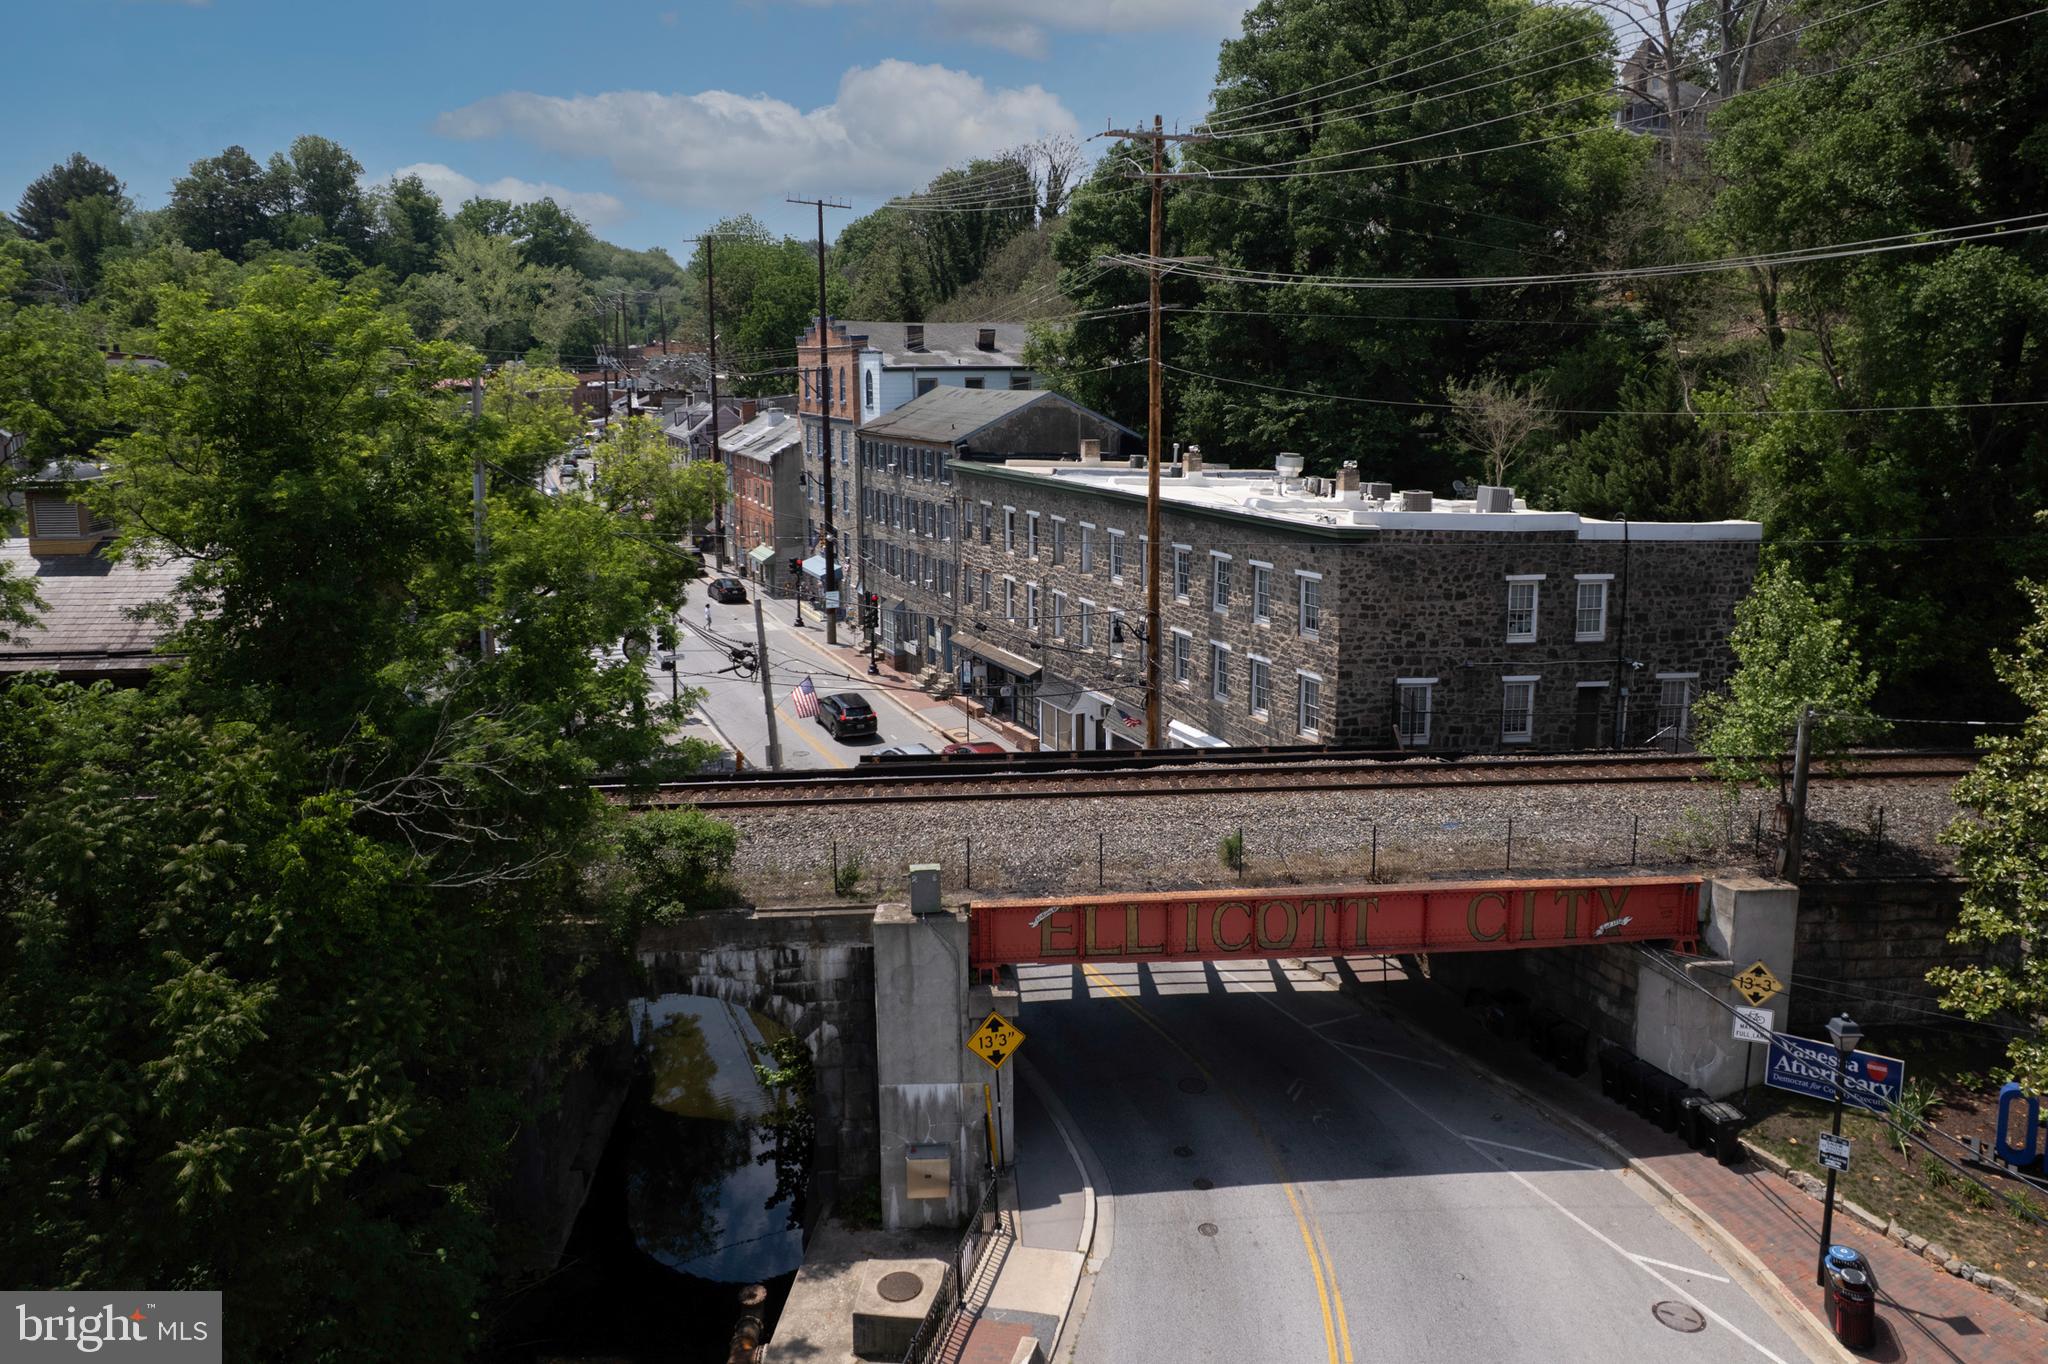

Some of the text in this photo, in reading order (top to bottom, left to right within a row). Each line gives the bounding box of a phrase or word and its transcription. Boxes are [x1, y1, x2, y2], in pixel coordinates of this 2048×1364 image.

[1039, 886, 1632, 957] ELLICOTT CITY
[1780, 1040, 1859, 1073] Vanesa
[1773, 1073, 1809, 1088] Democrat
[1810, 1082, 1821, 1090] for
